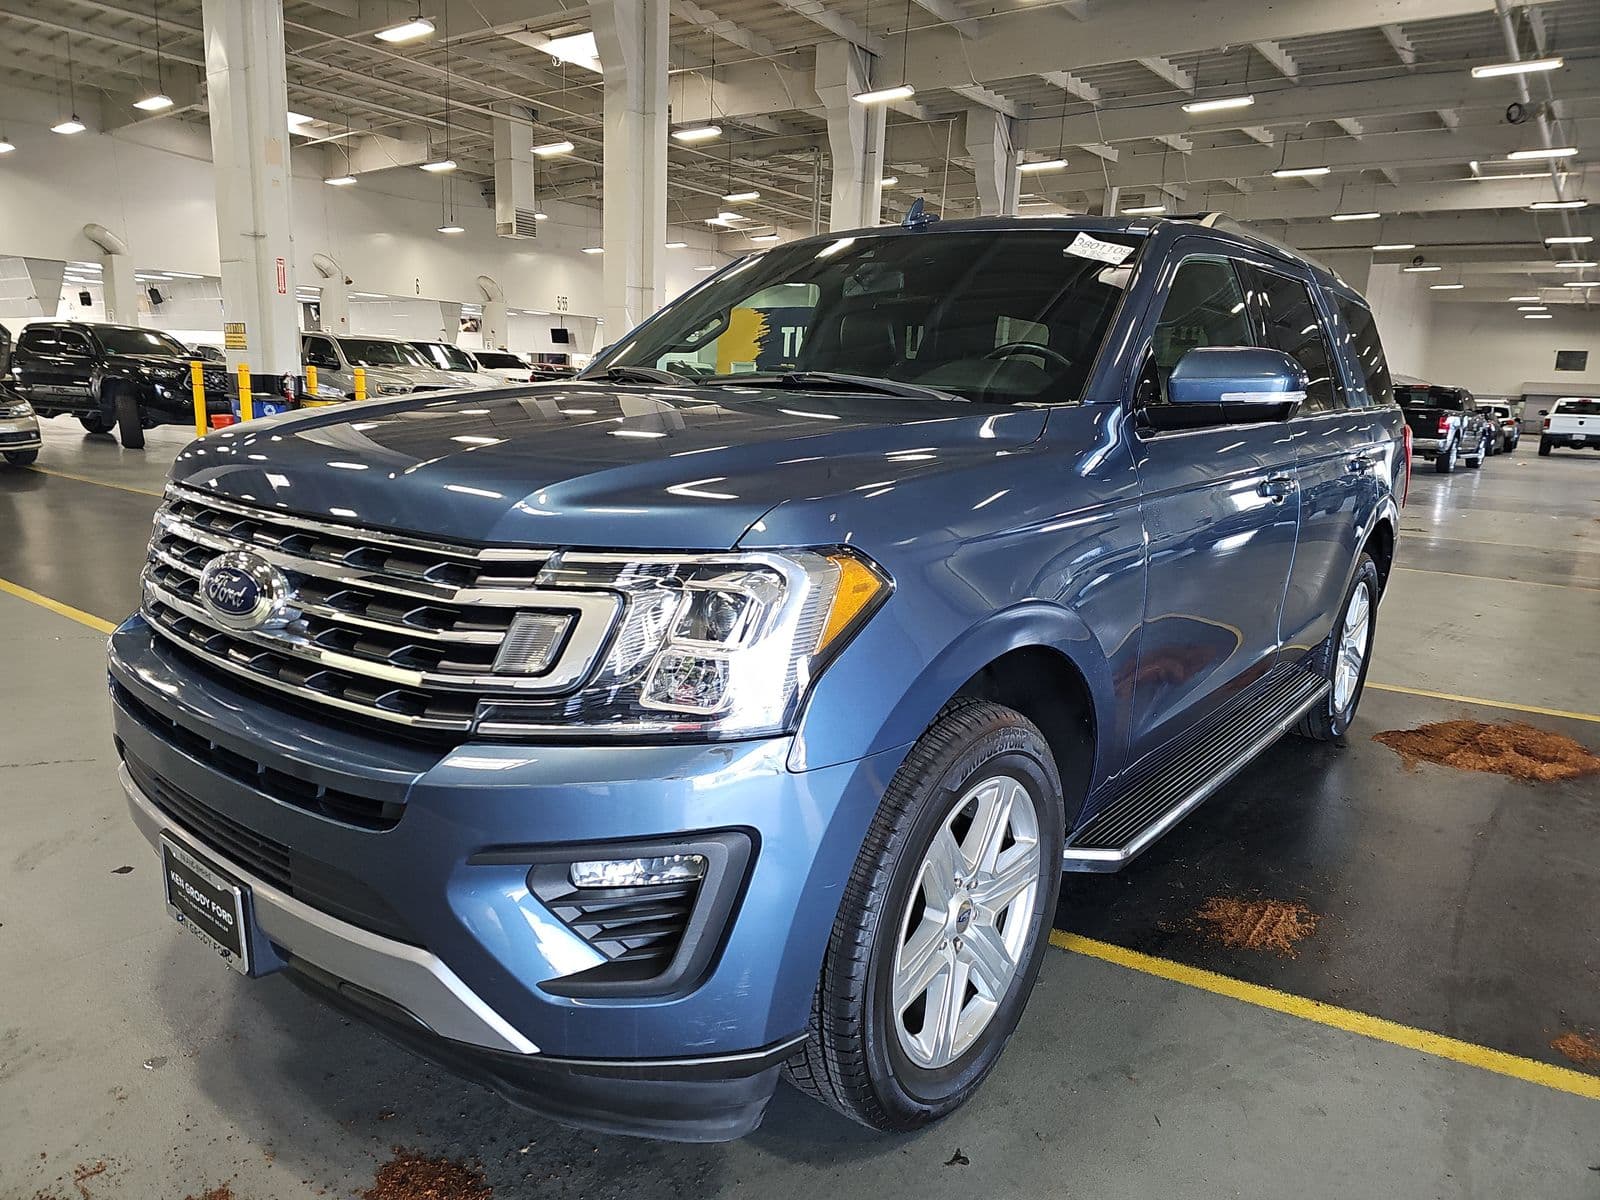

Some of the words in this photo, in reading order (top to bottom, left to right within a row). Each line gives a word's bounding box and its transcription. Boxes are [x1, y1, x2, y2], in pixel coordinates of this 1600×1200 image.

[416, 277, 420, 295] 6
[208, 570, 248, 608] Ford
[169, 870, 185, 890] KEN
[185, 882, 210, 909] GRODY
[210, 901, 233, 925] FORD
